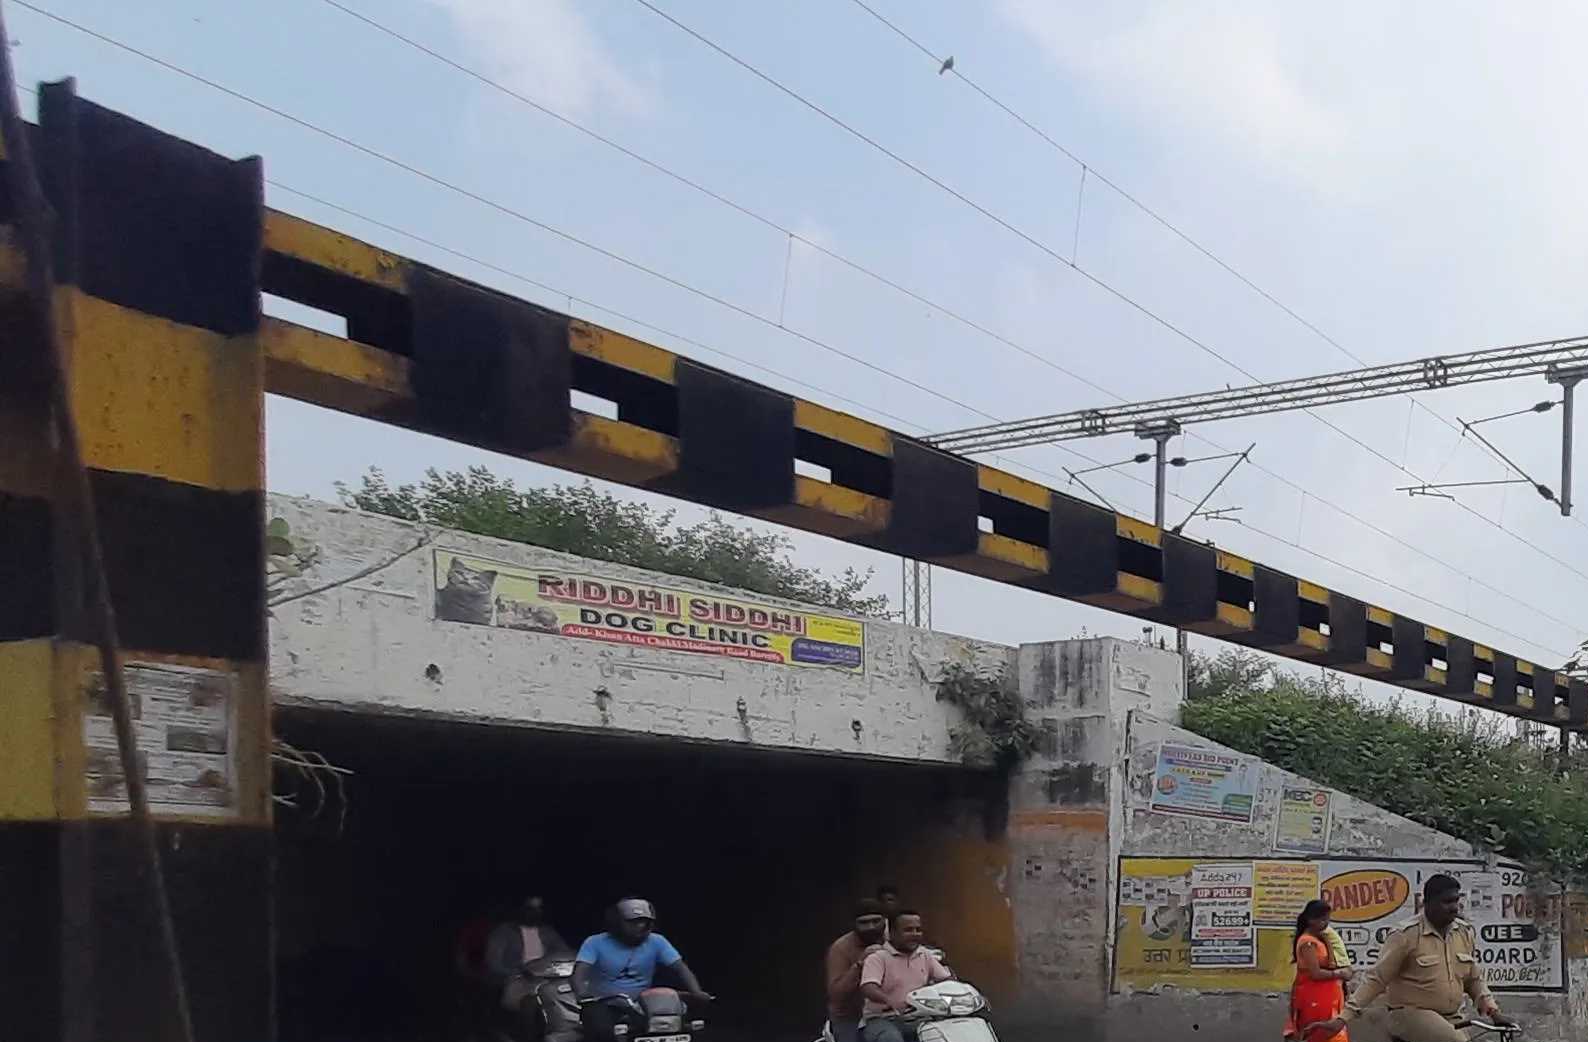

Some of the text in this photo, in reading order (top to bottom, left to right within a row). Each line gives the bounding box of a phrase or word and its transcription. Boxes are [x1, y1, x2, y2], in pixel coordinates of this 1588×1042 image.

[538, 575, 679, 615] RIDDHI
[689, 598, 803, 634] SIDDHI
[580, 608, 771, 648] DOG CLINIC
[1197, 887, 1247, 898] UP POLICE
[1321, 877, 1397, 912] PANDEY
[1485, 926, 1524, 939] JEE
[1473, 947, 1537, 964] BOARD
